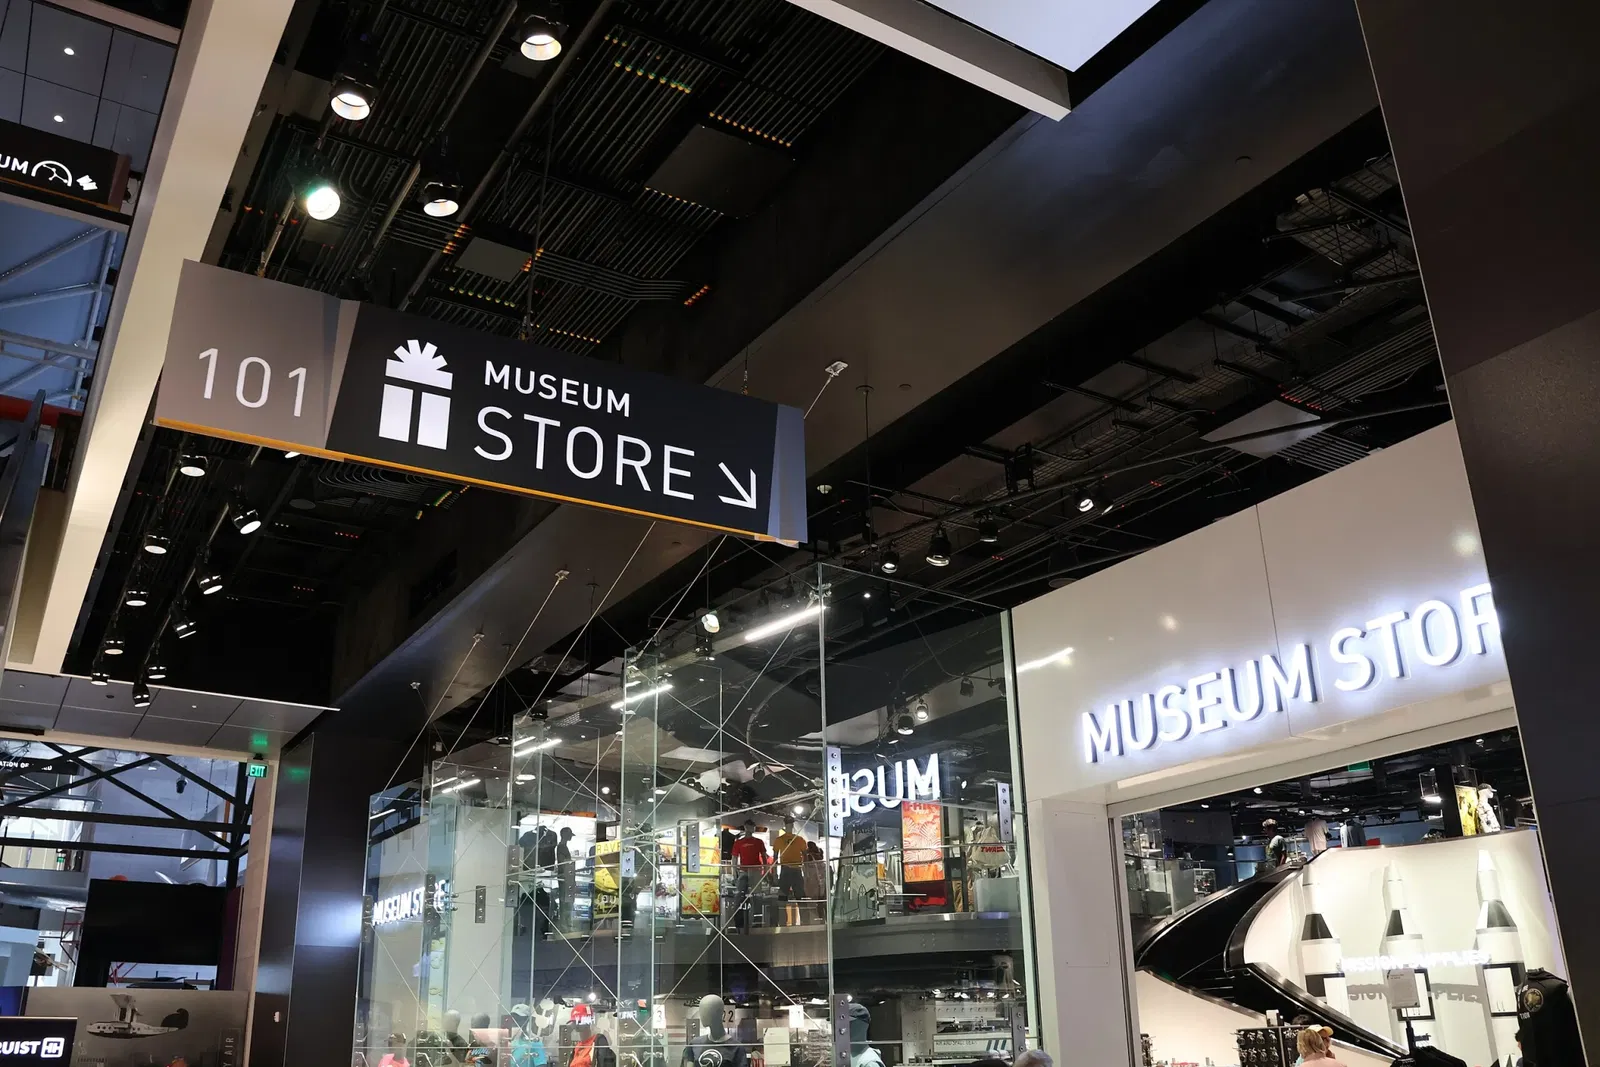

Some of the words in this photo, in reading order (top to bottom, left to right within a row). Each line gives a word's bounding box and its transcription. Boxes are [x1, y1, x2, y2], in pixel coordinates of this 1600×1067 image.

[198, 347, 307, 418] 101
[484, 360, 630, 417] MUSEUM
[473, 406, 695, 501] STORE
[1081, 643, 1319, 764] MUSEUM
